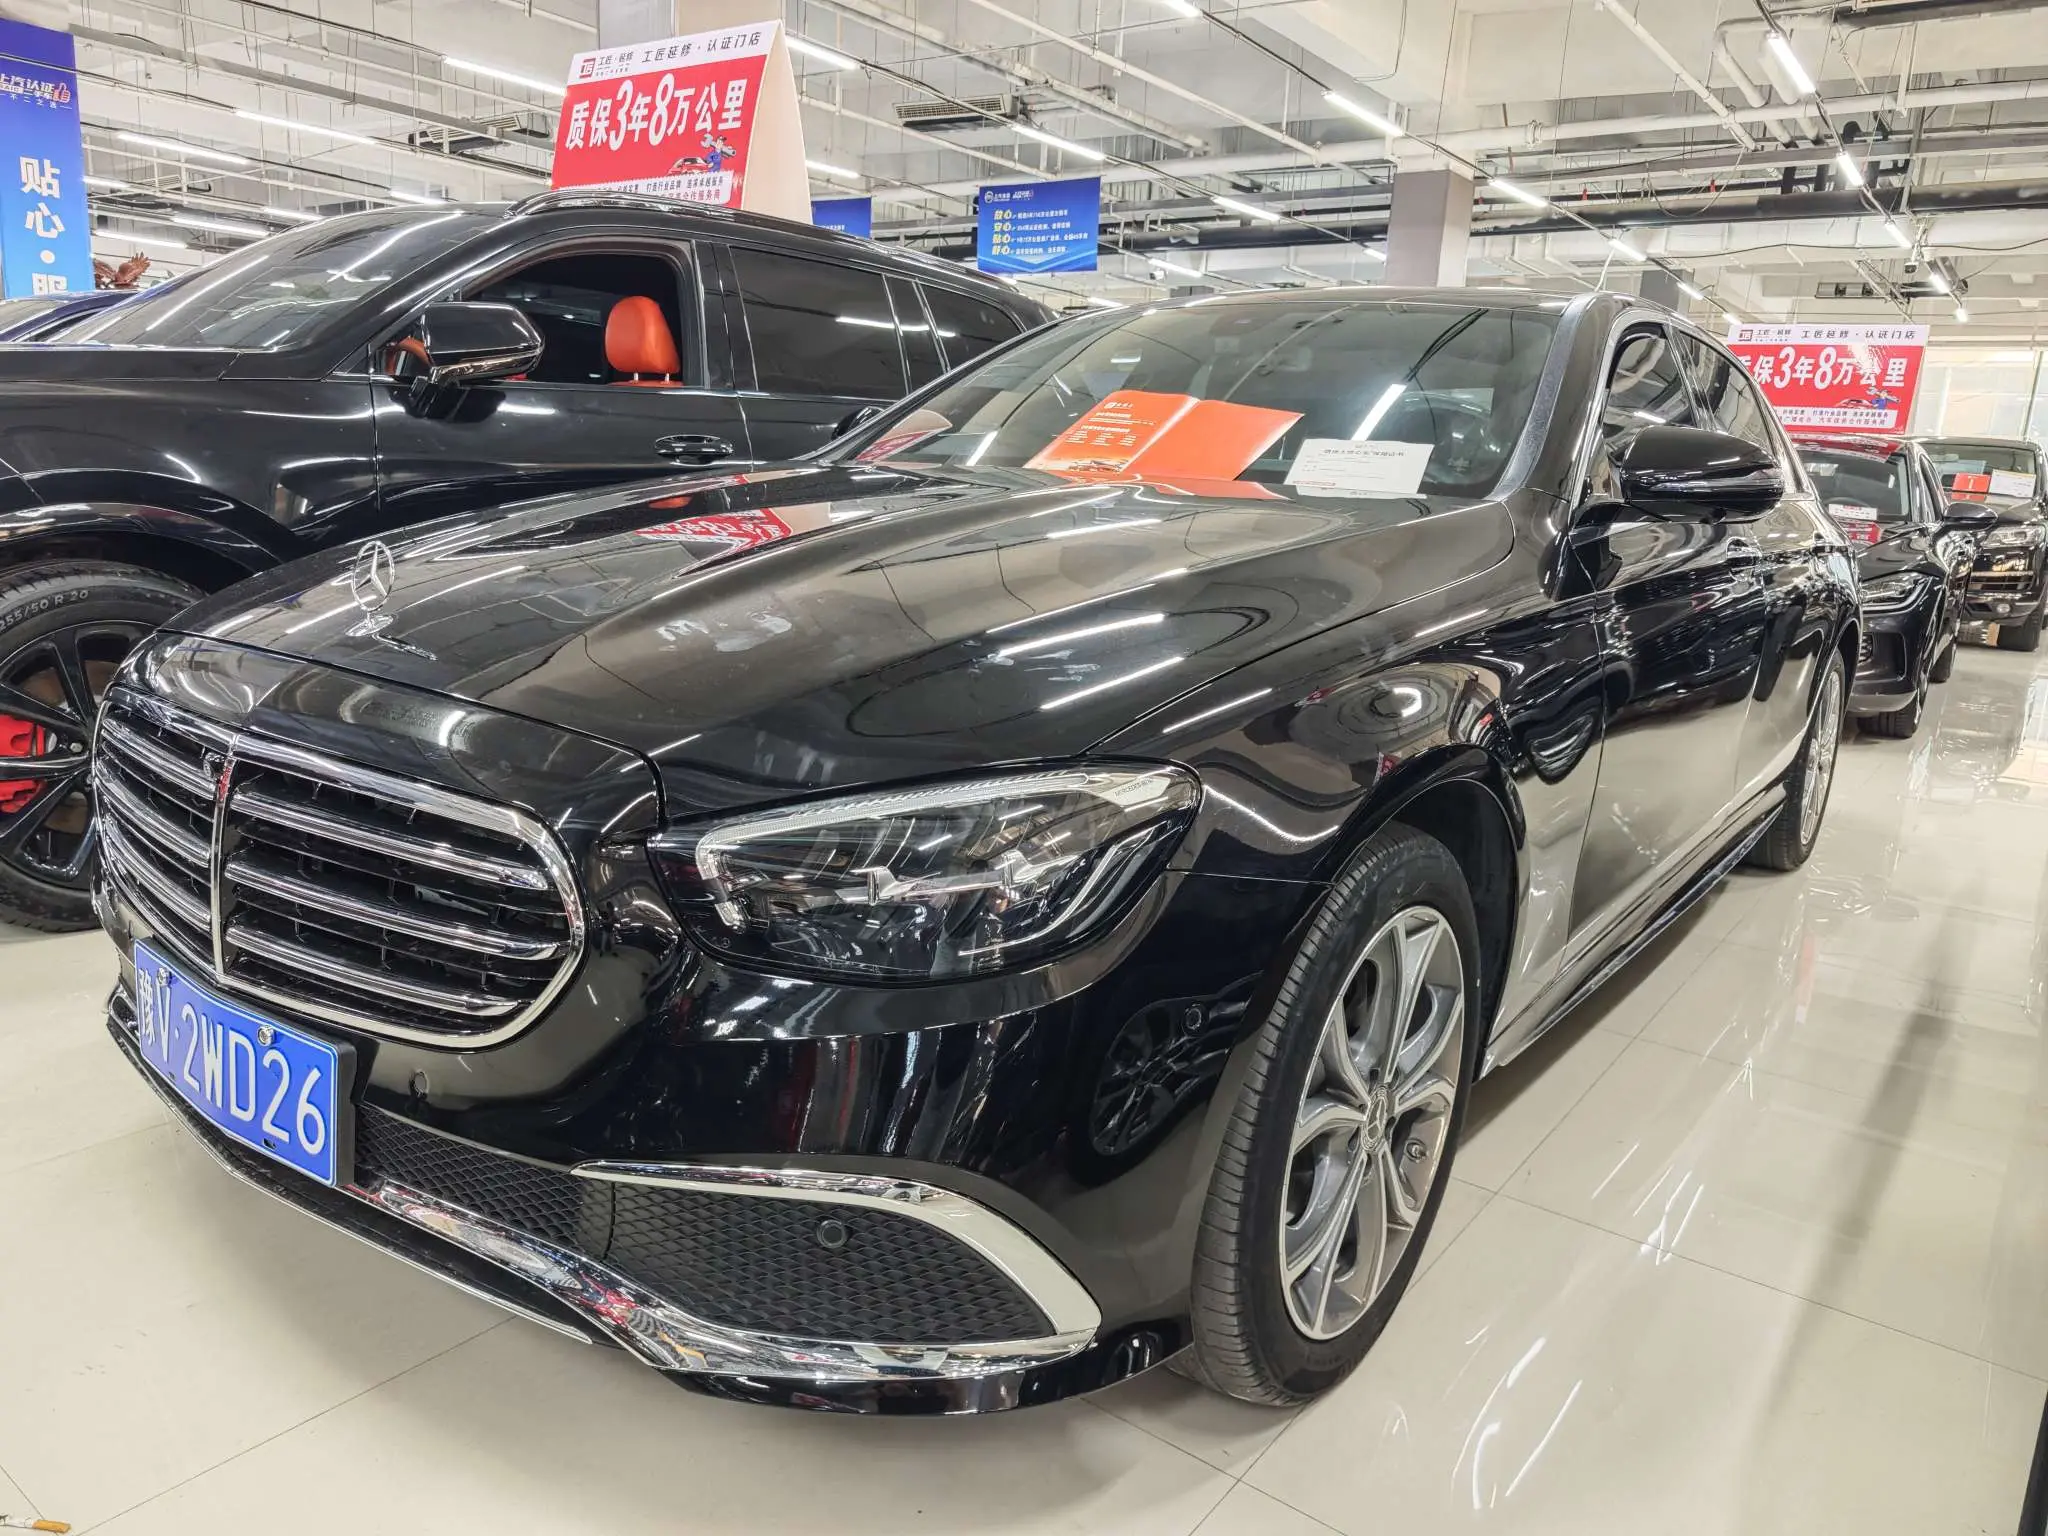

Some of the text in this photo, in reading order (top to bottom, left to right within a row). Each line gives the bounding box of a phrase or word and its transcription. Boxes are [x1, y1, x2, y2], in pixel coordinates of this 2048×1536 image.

[565, 73, 748, 152] 质保3年8万公里
[0, 590, 89, 631] 255/50 R 20
